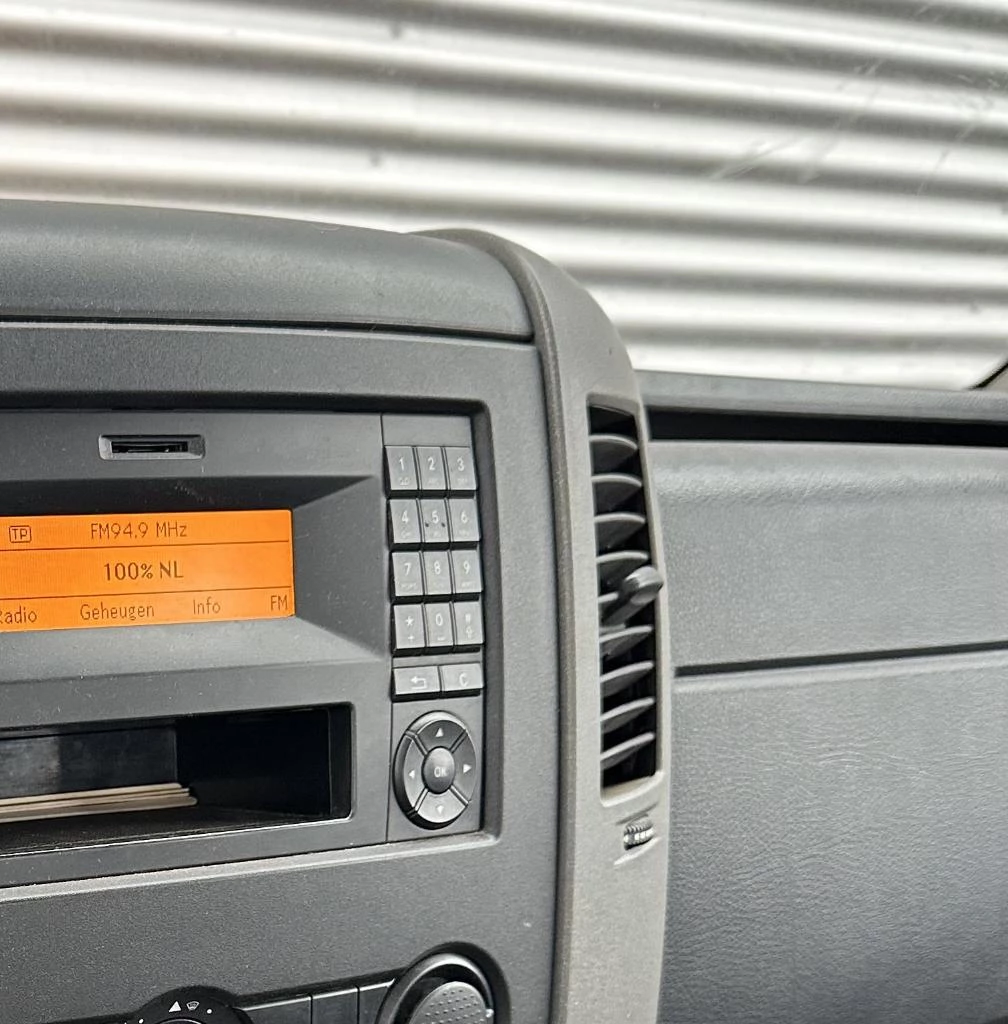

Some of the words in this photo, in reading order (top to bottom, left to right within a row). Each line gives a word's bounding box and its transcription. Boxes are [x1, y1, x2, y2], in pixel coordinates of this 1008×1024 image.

[398, 457, 405, 471] 1
[427, 457, 436, 471] 2
[456, 457, 465, 472] 3
[401, 510, 409, 524] 4
[431, 510, 440, 524] 5
[460, 510, 468, 524] 6
[10, 527, 29, 541] TP
[90, 521, 149, 541] FM94.9
[155, 521, 188, 539] MHz
[103, 562, 154, 581] 100%
[159, 560, 185, 579] NL
[403, 562, 412, 576] 7
[433, 560, 442, 575] 8
[463, 560, 471, 575] 9
[79, 602, 155, 622] Geheugen
[192, 595, 222, 615] Info
[269, 595, 289, 612] FM
